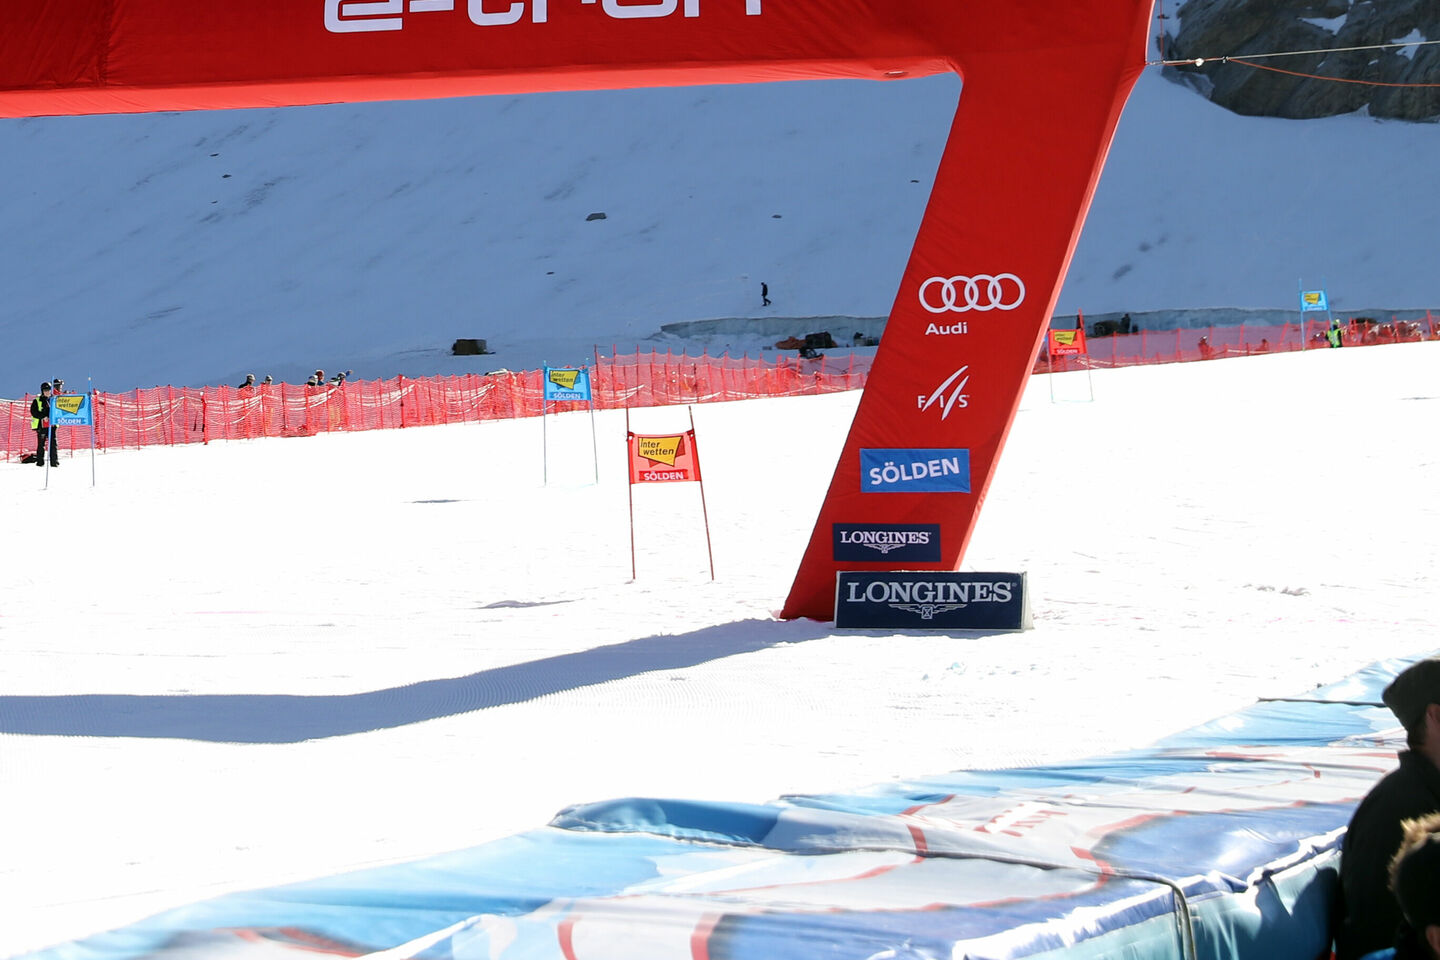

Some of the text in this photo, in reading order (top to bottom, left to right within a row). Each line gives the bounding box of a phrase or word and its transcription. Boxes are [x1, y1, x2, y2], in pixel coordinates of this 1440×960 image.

[925, 322, 969, 335] Audi
[643, 448, 674, 456] wetten
[643, 470, 684, 481] SÖLDEN
[869, 457, 960, 485] SÖLDEN
[840, 531, 930, 545] LONGINES
[846, 581, 1013, 604] LONGINES
